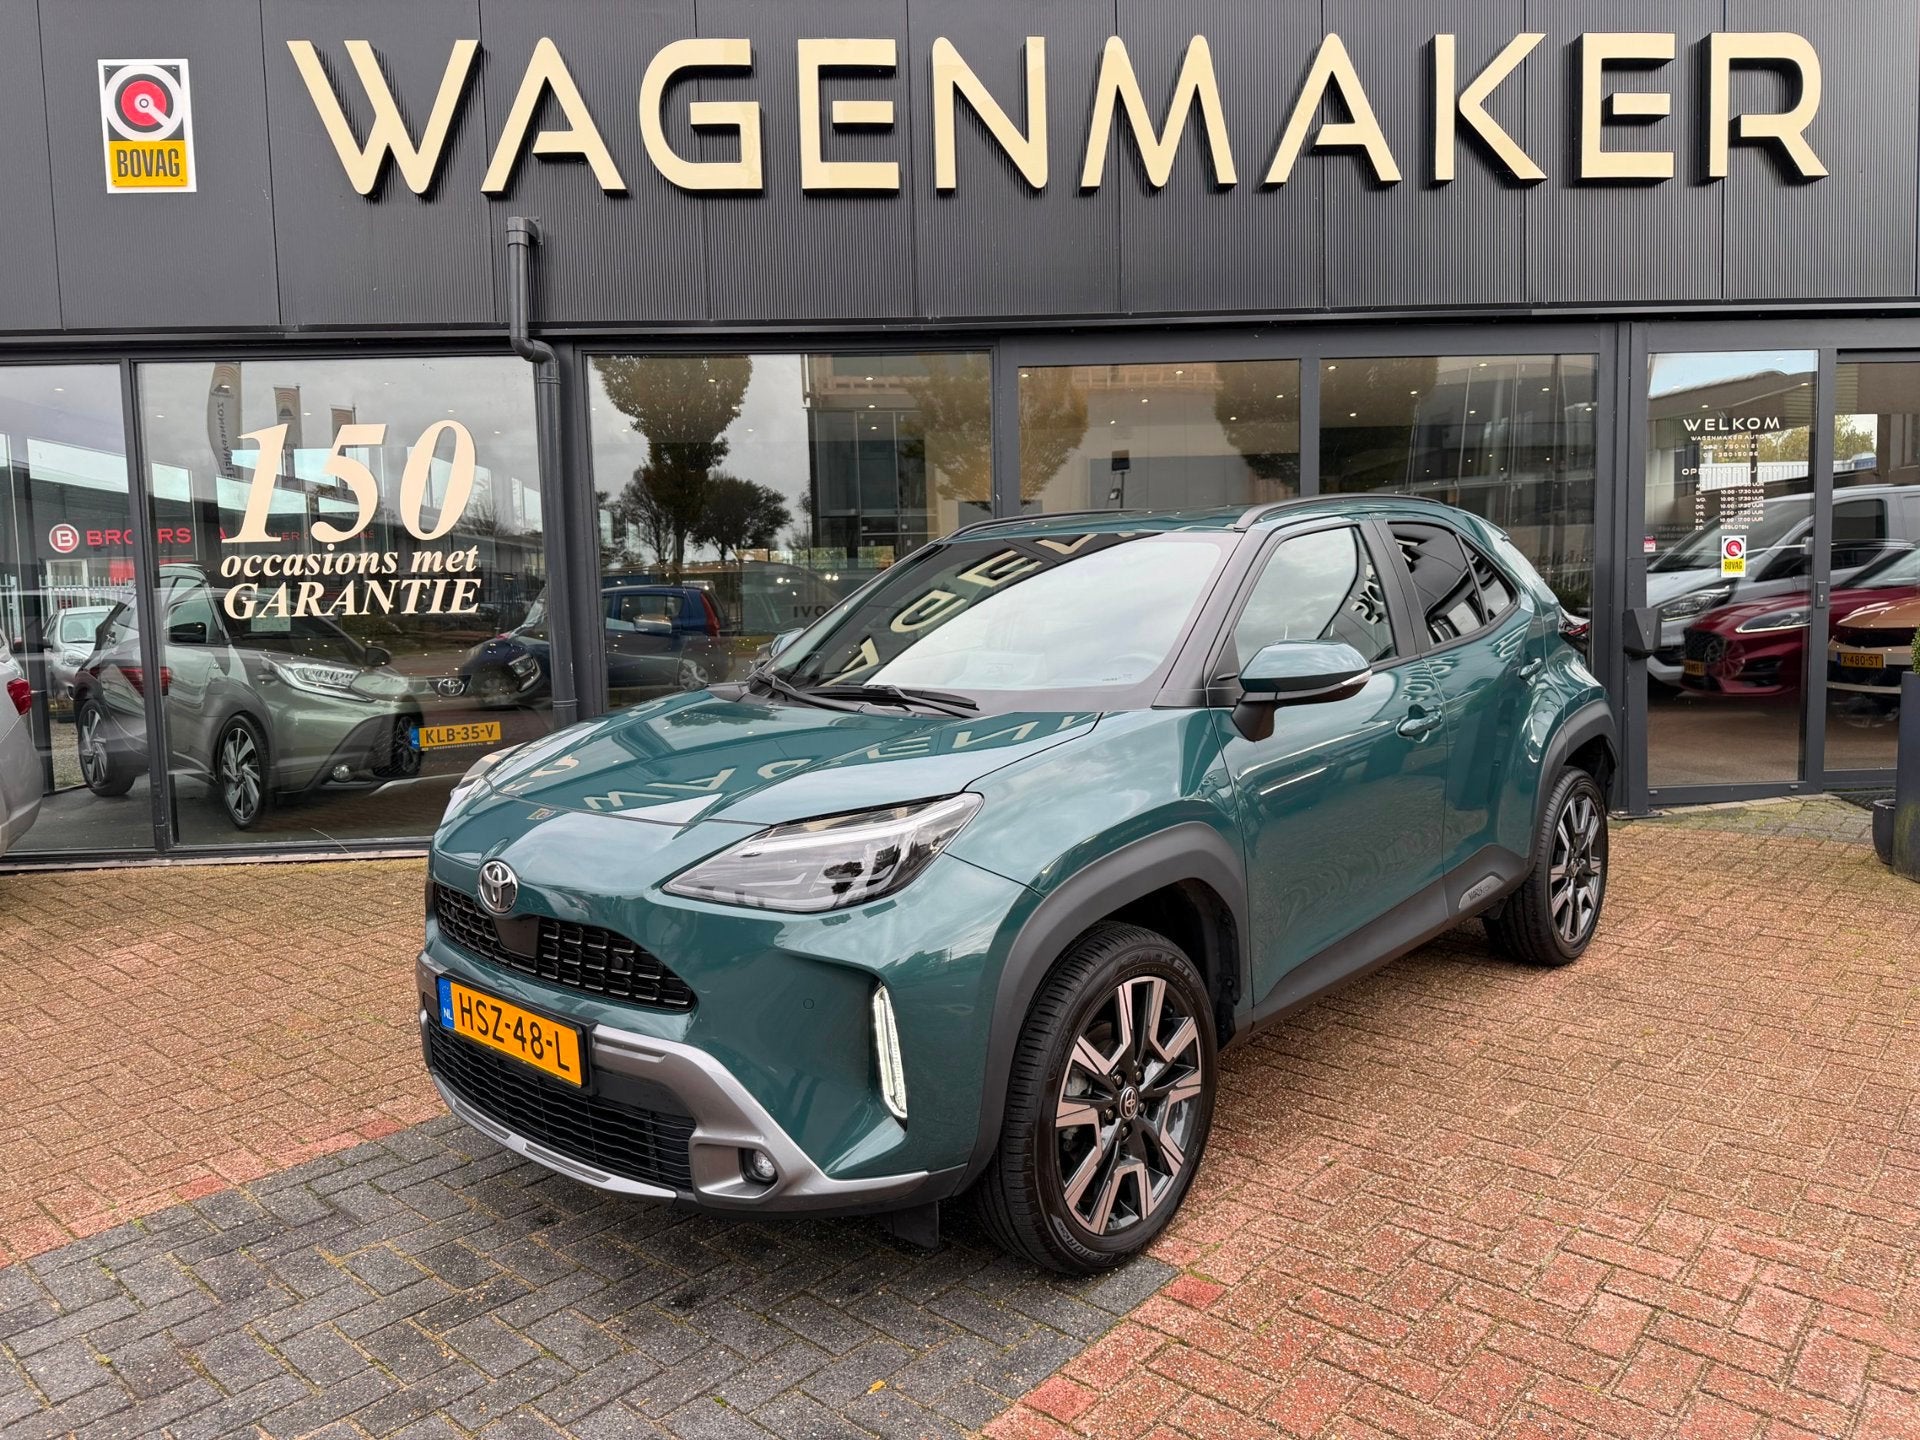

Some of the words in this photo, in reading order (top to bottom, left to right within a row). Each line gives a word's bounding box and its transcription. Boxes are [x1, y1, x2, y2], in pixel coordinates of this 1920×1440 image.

[287, 31, 1830, 197] WAGENMAKER
[116, 147, 181, 179] BOVAG
[1683, 416, 1780, 431] WELKOM
[221, 419, 476, 544] 150
[86, 527, 192, 546] BRORS
[220, 543, 399, 578] occasions
[410, 544, 479, 573] met
[1724, 561, 1743, 570] BOVAG
[223, 578, 482, 620] GARANTIE
[425, 724, 495, 744] KLB-35-V
[443, 1007, 453, 1021] NL
[458, 991, 571, 1073] HSZ-48-L
